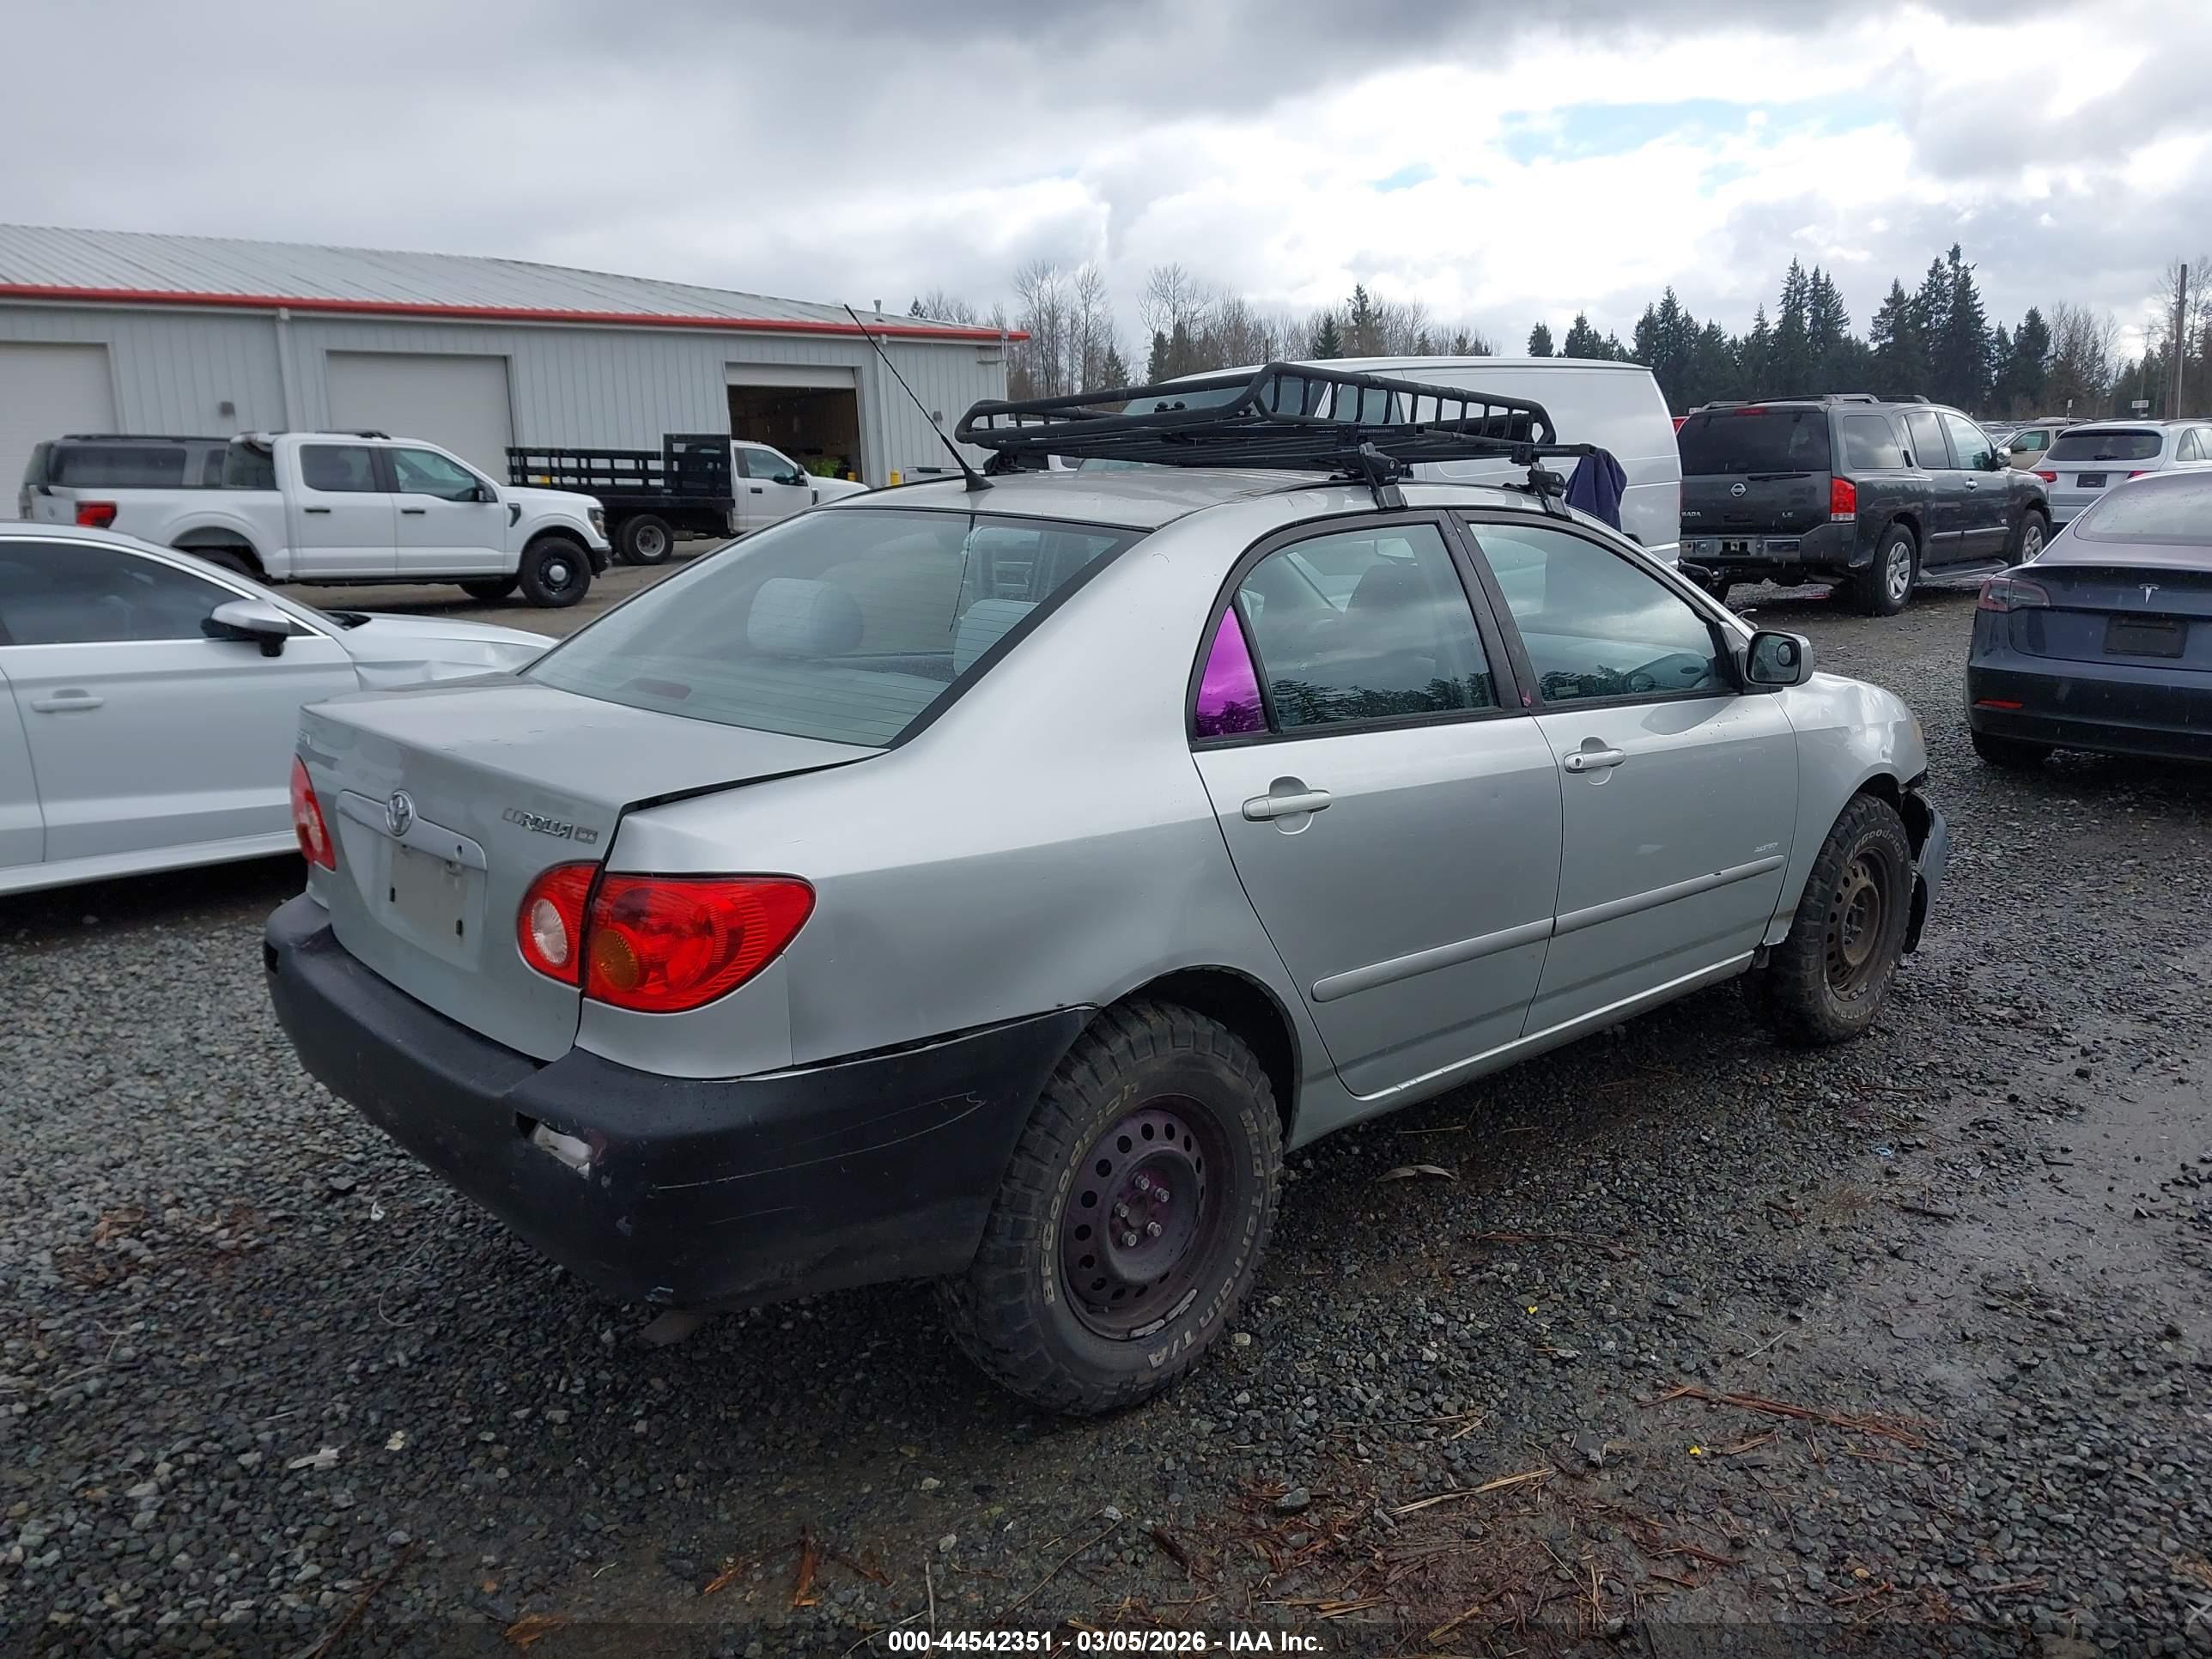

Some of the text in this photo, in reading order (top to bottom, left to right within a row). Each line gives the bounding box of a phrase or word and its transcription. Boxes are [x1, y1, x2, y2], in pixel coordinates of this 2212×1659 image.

[1846, 828, 1905, 866] BFGoodrich
[1040, 1082, 1140, 1306] BFGoodrich
[1147, 1328, 1197, 1369] T/A
